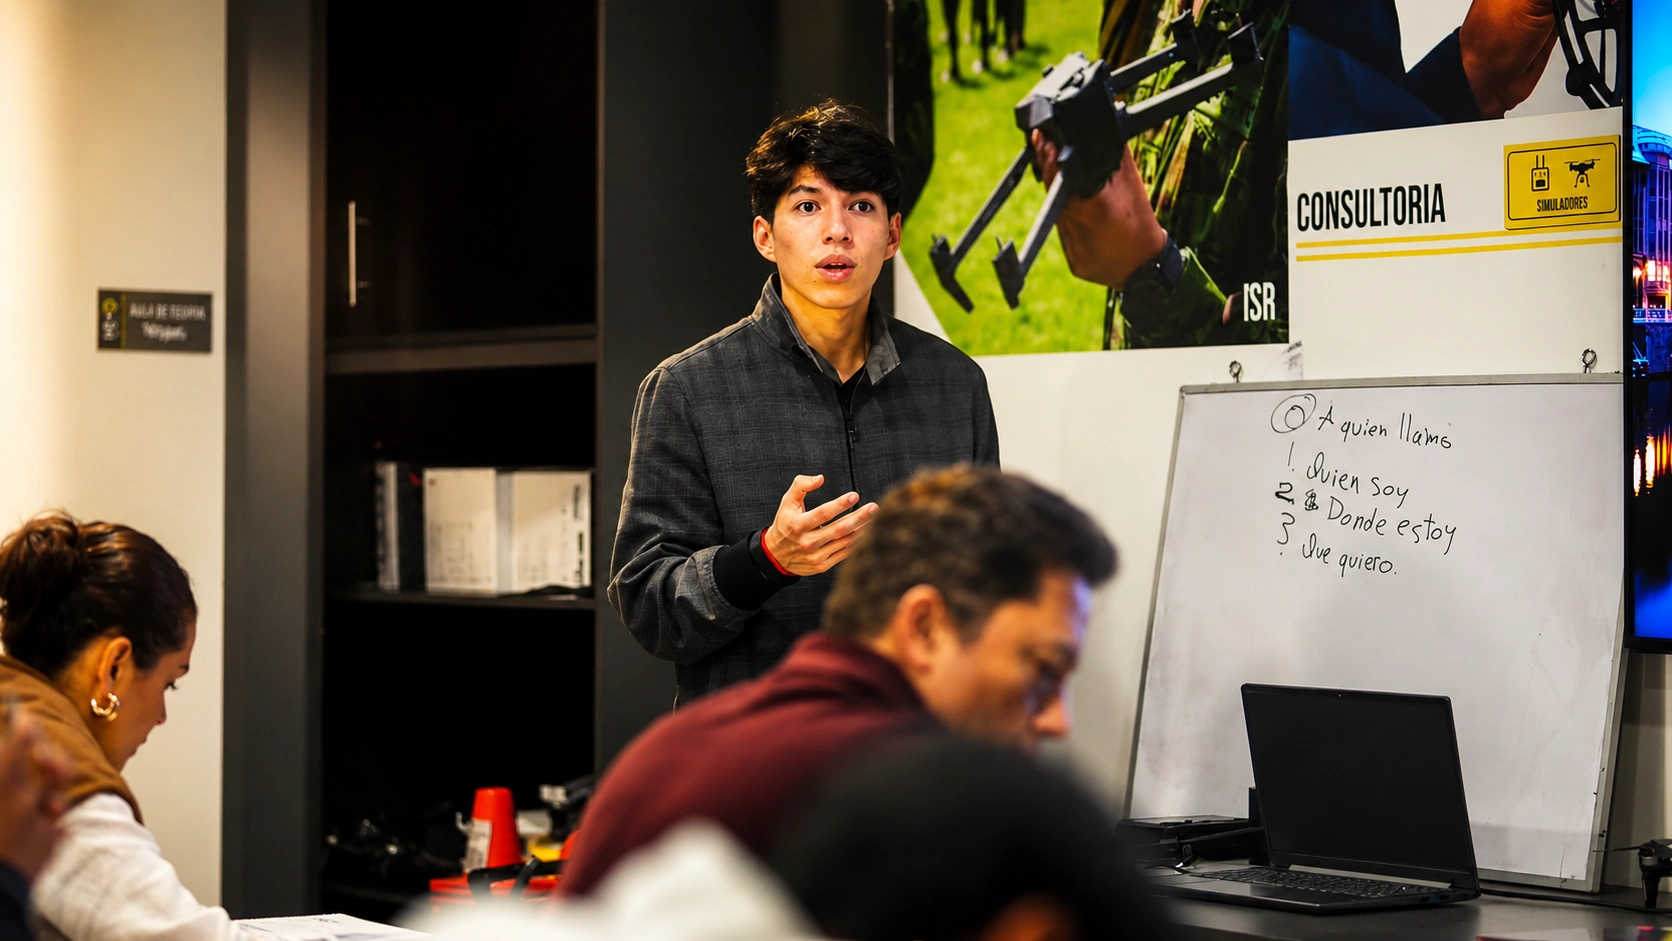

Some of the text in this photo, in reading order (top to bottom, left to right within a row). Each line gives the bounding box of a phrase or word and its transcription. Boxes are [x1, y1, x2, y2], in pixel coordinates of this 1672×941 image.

[1296, 183, 1446, 232] CONSULTORIA
[1536, 196, 1589, 212] SIMULADORES
[1243, 281, 1276, 322] ISR
[1318, 405, 1335, 431] A
[1340, 418, 1388, 442] quien
[1306, 451, 1359, 494] Quien
[1327, 496, 1387, 536] Donde
[1397, 513, 1457, 556] estoy
[1302, 532, 1331, 564] Que
